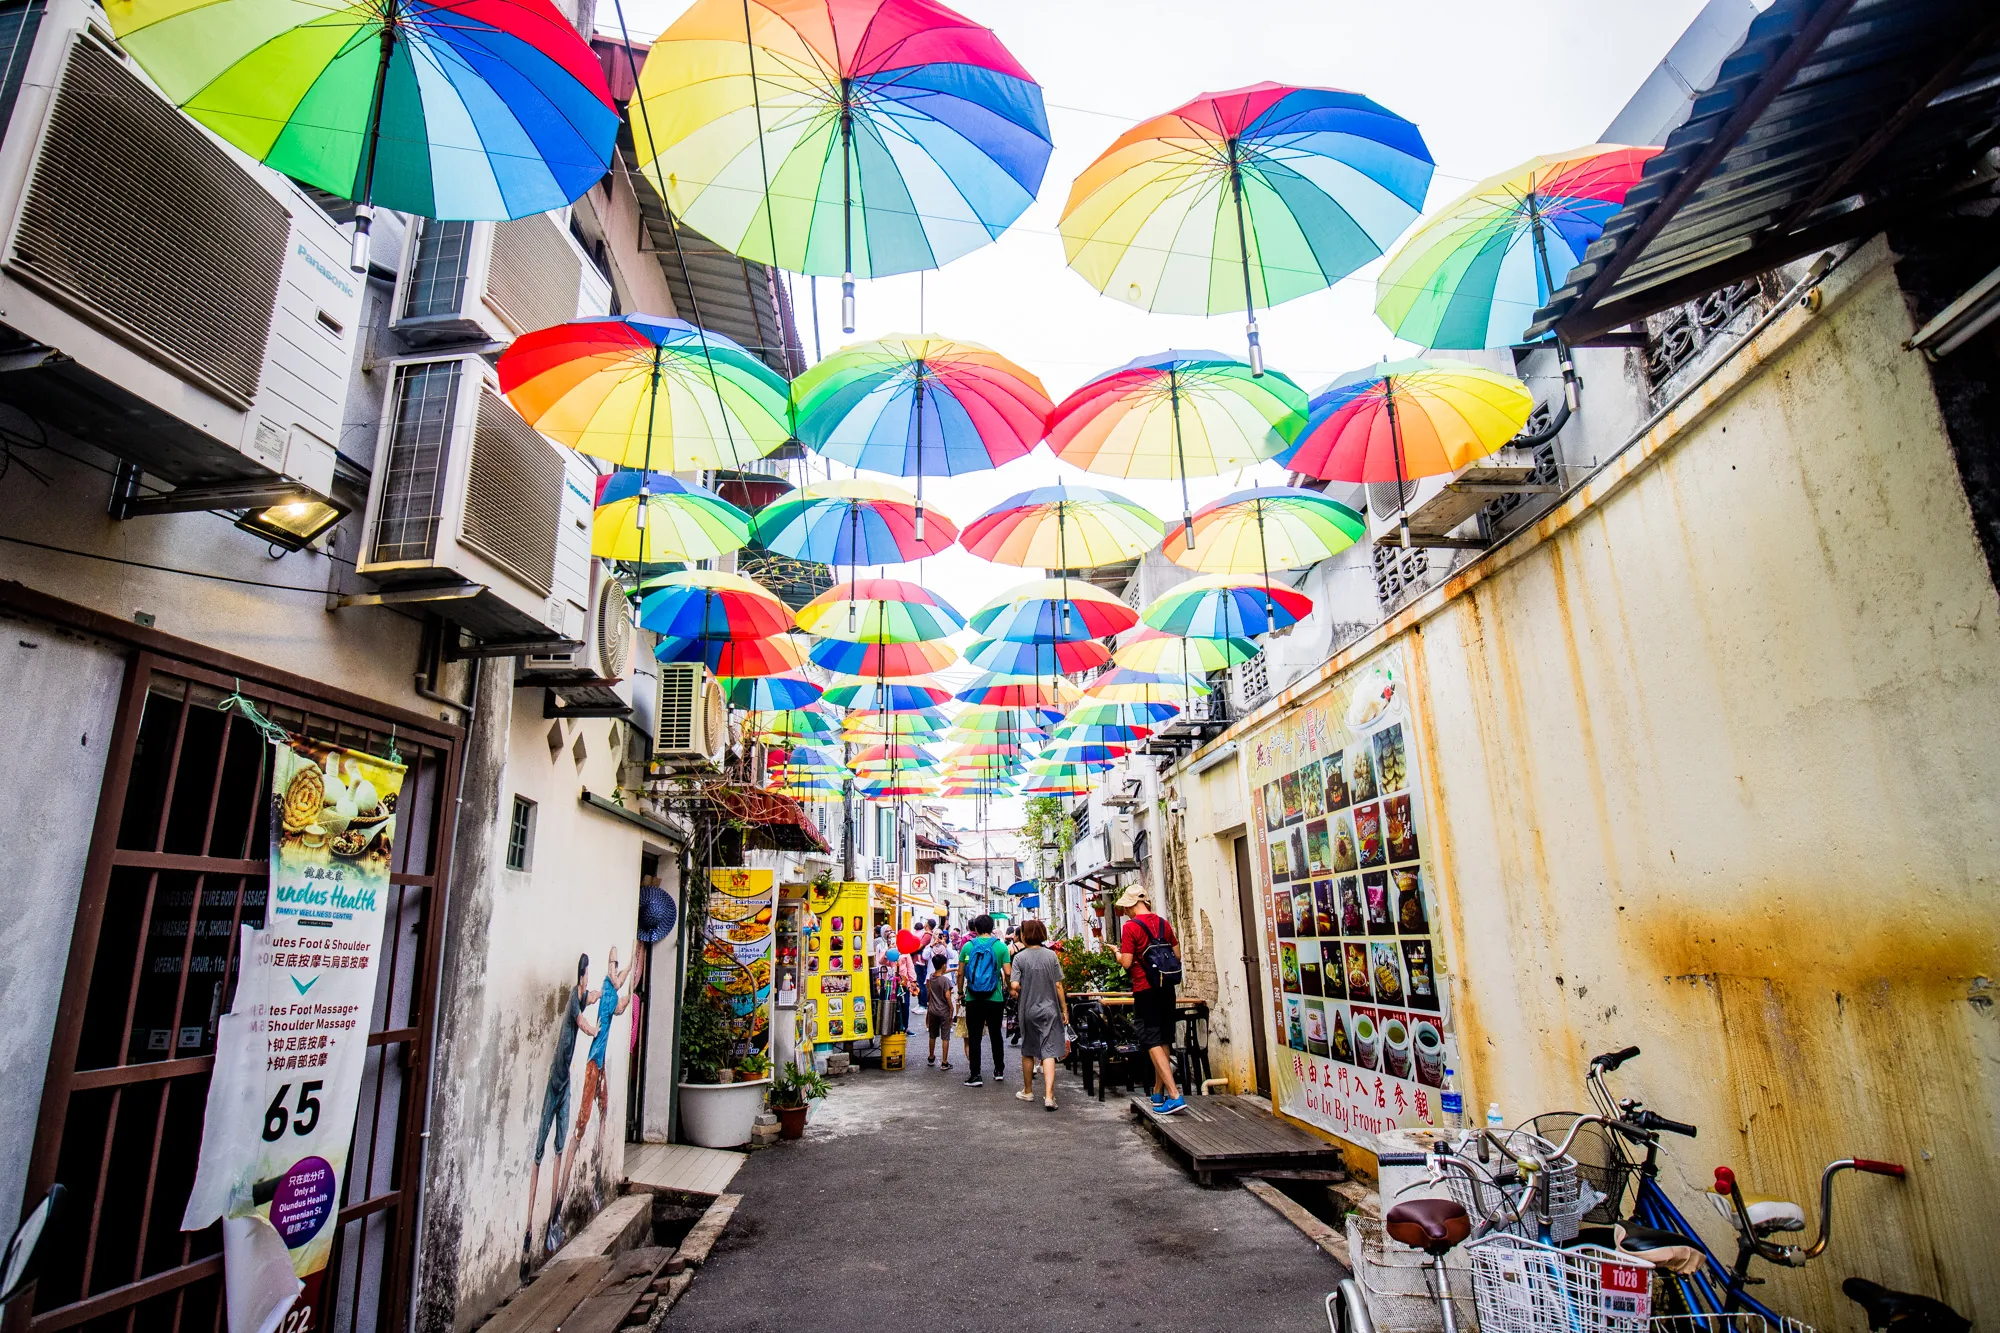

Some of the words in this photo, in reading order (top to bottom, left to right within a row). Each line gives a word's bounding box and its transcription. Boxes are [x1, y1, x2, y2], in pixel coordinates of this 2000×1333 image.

[297, 244, 354, 298] Panasonic
[241, 889, 267, 906] ASSAGE
[330, 884, 378, 912] Health
[275, 906, 299, 917] FAMILY
[299, 908, 332, 919] WELLNESS
[332, 911, 354, 921] CENTRE
[298, 937, 322, 949] Foot
[323, 939, 331, 950] &
[331, 939, 371, 951] Shoulder
[270, 952, 369, 969] 足底按摩与肩部按摩
[290, 1004, 312, 1015] Foot
[267, 1020, 315, 1032] Shoulder
[316, 1018, 357, 1031] Massage
[1293, 1052, 1434, 1126] 請由正門入店參觀
[262, 1080, 324, 1142] 65
[1306, 1088, 1319, 1111] Go
[1320, 1093, 1332, 1116] In
[1334, 1097, 1349, 1134] By
[1352, 1104, 1382, 1135] Front
[288, 1169, 326, 1187] 只在此分行
[294, 1186, 309, 1197] Only
[309, 1185, 316, 1194] at
[279, 1199, 306, 1213] Olundus
[307, 1193, 328, 1206] Health
[281, 1209, 314, 1225] Armenian
[314, 1206, 323, 1215] St.
[286, 1218, 317, 1235] 健康之家
[1612, 1269, 1638, 1289] T028
